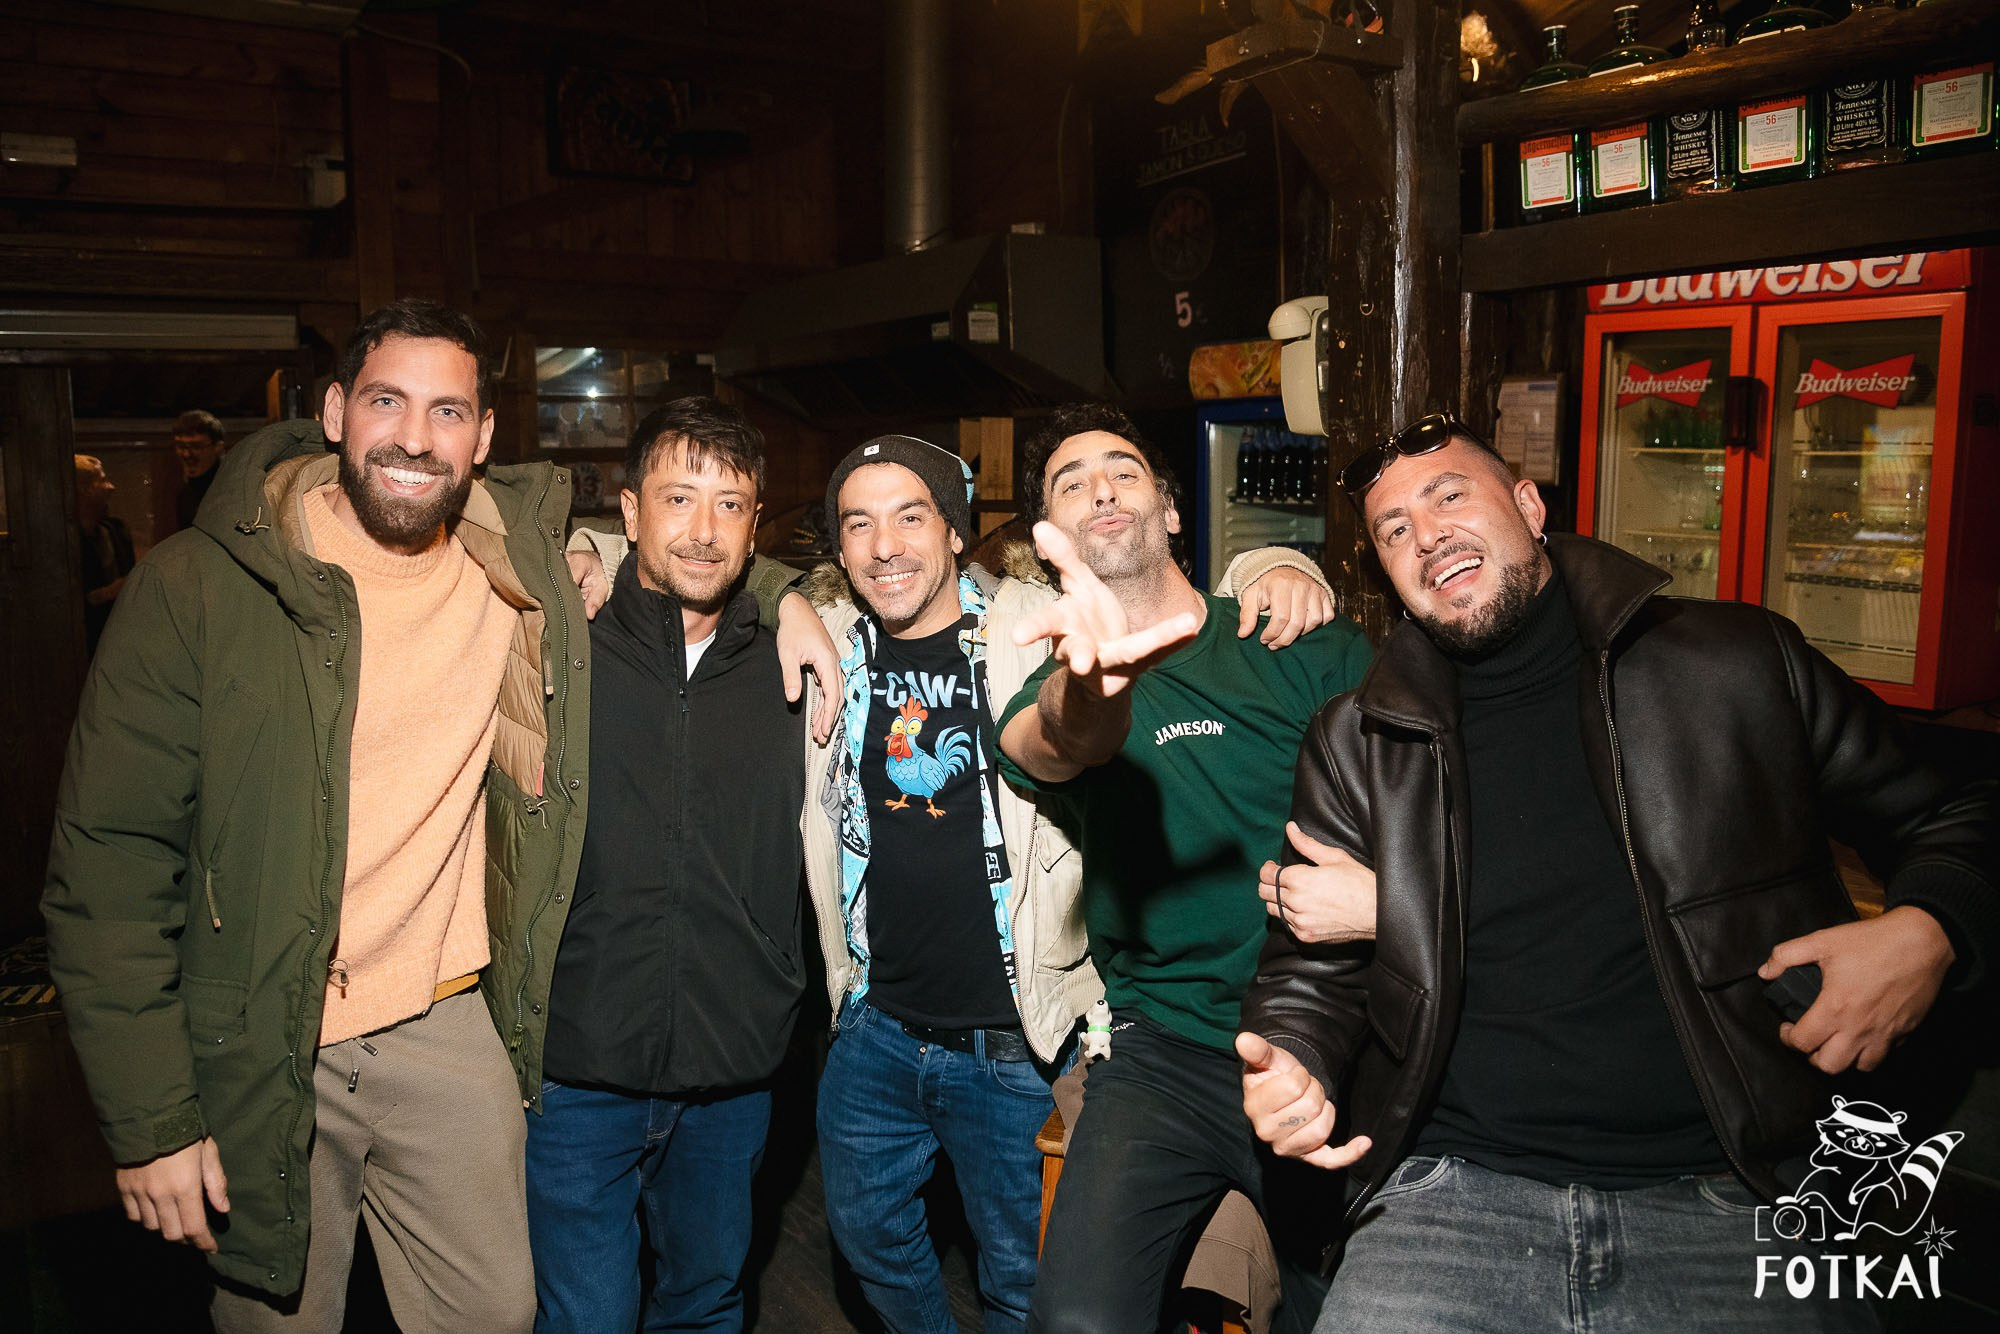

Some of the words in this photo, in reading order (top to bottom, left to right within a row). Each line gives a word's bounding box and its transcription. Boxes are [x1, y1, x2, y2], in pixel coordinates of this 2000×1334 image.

[1945, 81, 1958, 93] 56
[1835, 98, 1876, 111] Tennessee
[1766, 114, 1776, 125] 56
[1835, 110, 1875, 122] WHISKEY
[1613, 144, 1623, 153] 56
[1674, 140, 1706, 151] WHISKEY
[1541, 157, 1551, 167] 56
[1600, 252, 1926, 306] Budweiser
[1617, 375, 1712, 395] Budweiser
[1794, 372, 1916, 394] Budweiser
[869, 671, 971, 708] -CAW-
[1155, 720, 1223, 746] JAMESON
